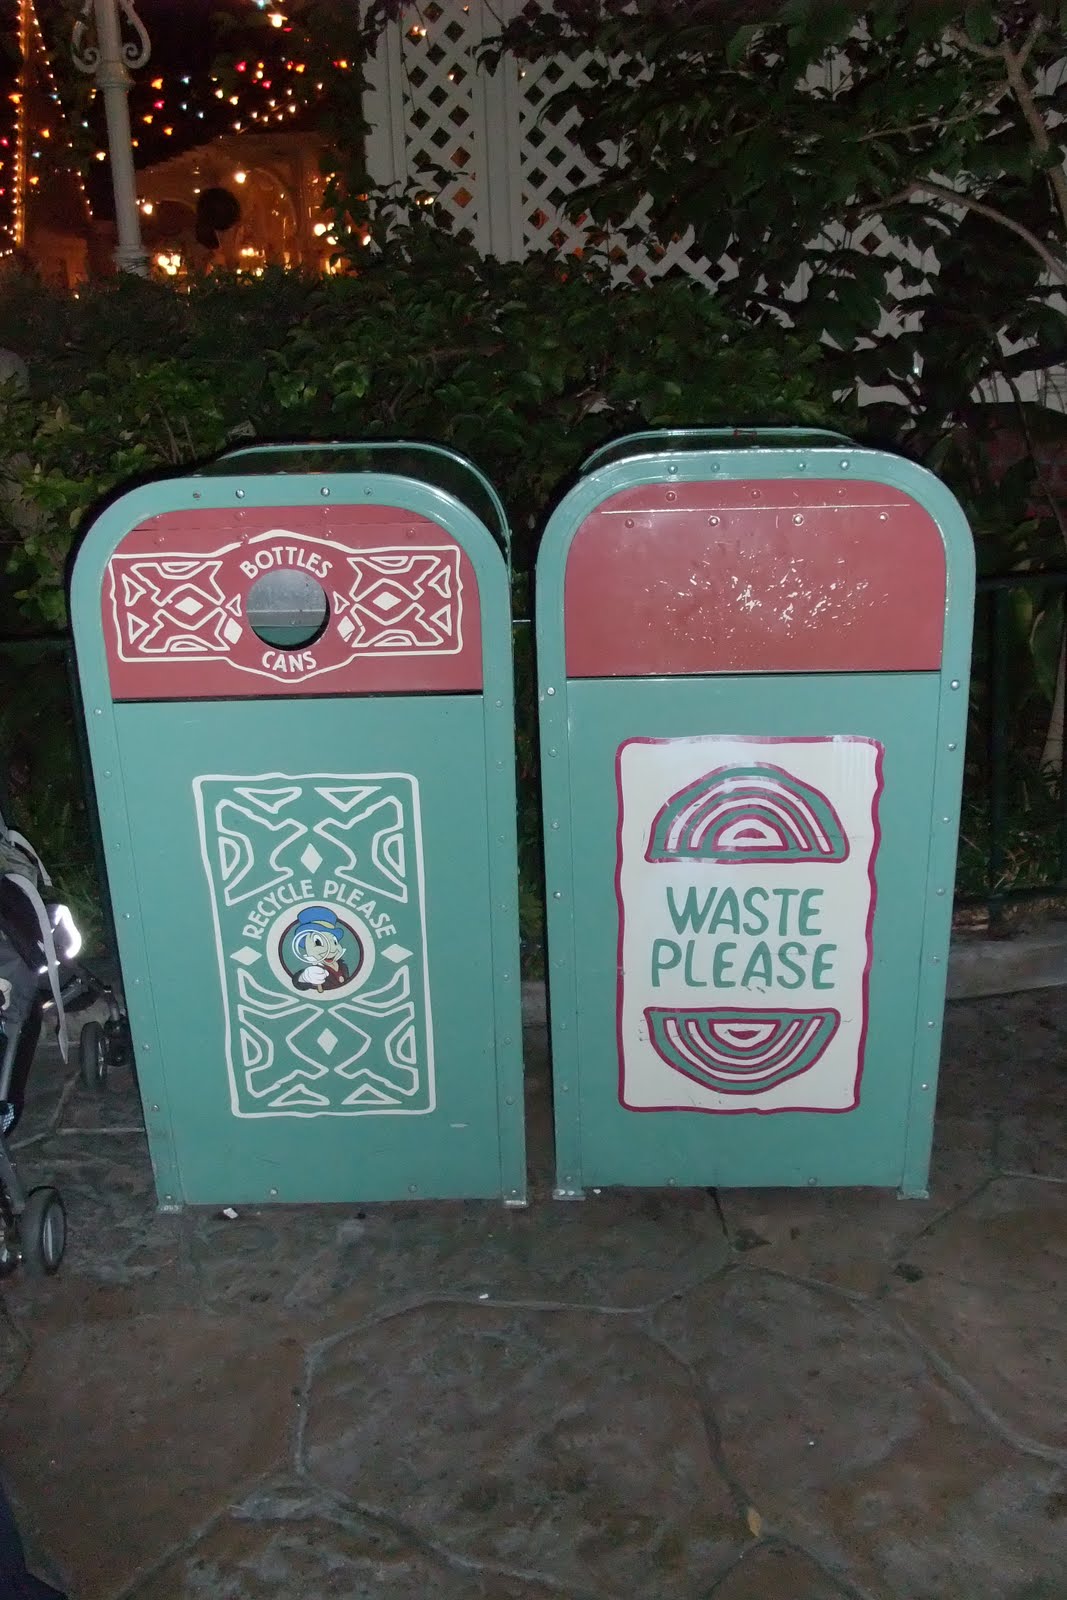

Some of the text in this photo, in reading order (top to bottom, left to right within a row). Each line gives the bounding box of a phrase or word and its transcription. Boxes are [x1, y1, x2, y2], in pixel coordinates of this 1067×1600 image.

[240, 546, 333, 579] BOTTLES
[261, 651, 317, 672] CANS
[242, 879, 397, 940] RECYCLE PLEASE
[666, 886, 824, 936] WASTE
[651, 938, 837, 990] PLEASE
